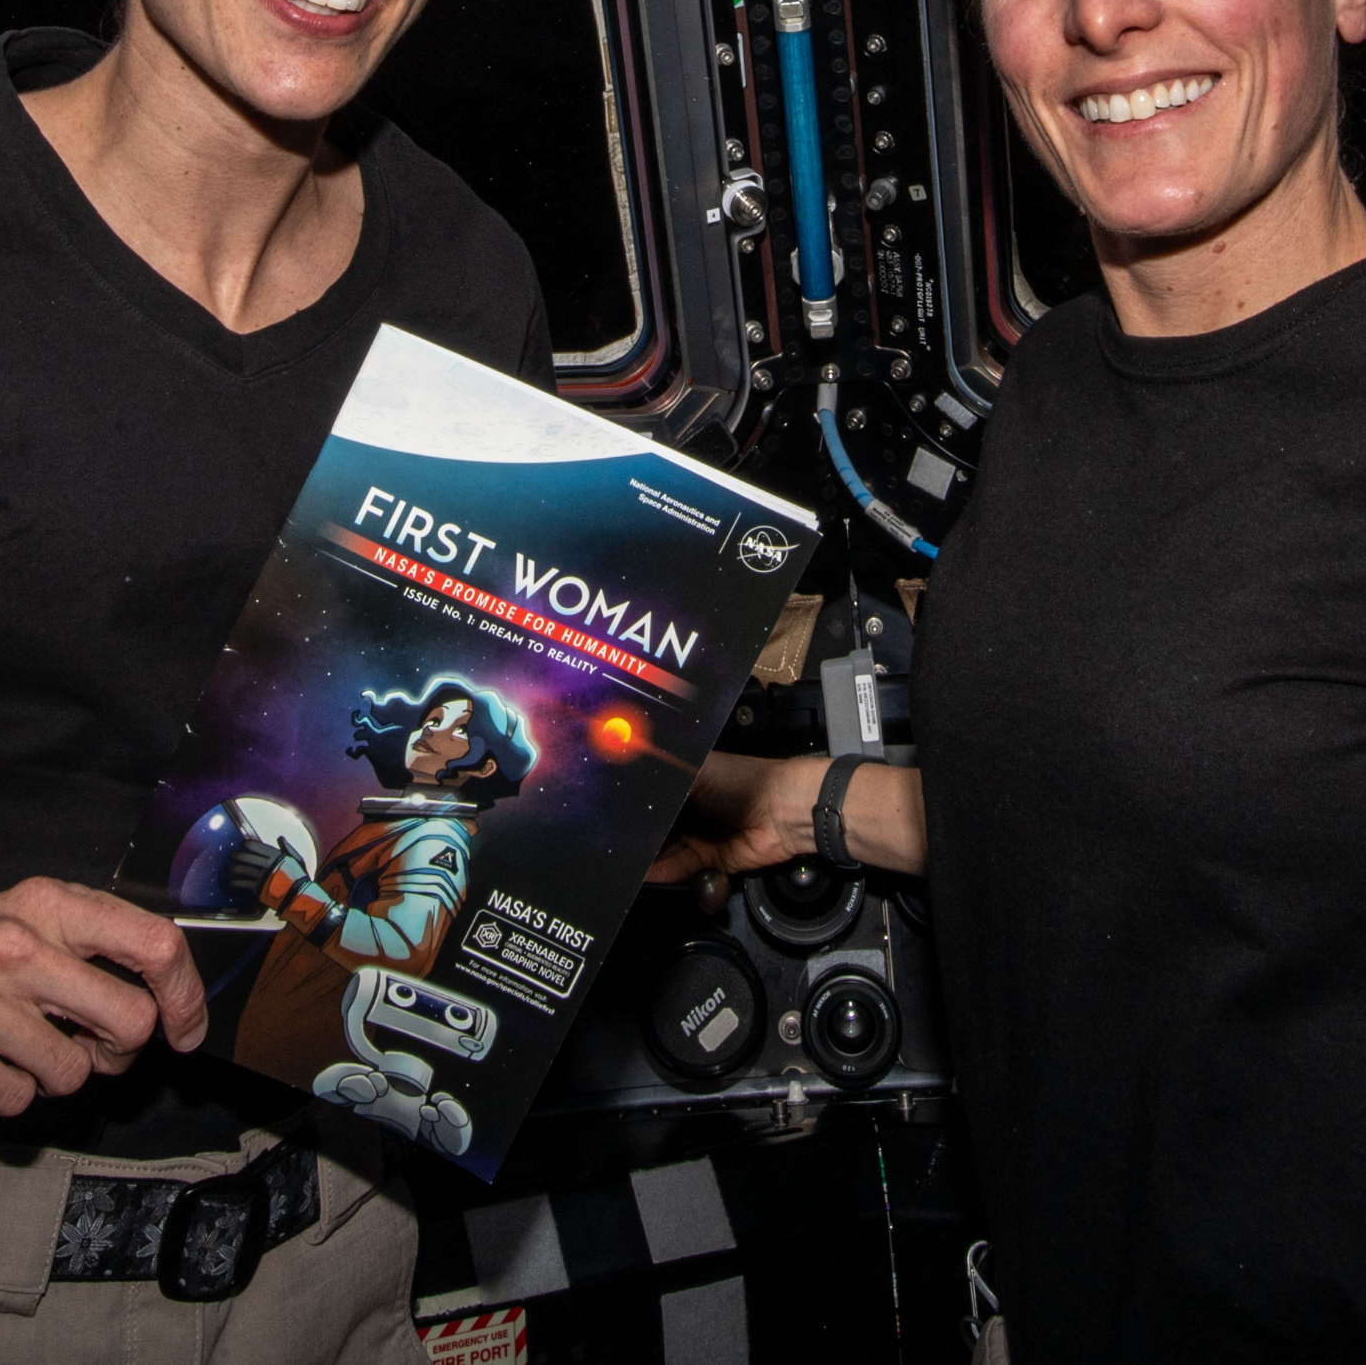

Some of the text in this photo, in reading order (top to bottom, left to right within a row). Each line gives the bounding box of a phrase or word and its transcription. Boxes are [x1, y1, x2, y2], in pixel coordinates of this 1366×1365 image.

[913, 187, 920, 197] 7
[629, 478, 721, 528] National Aeronautics and
[638, 493, 716, 536] Space Administration
[744, 536, 783, 563] NASA
[354, 486, 699, 669] FIRST WOMAN
[373, 546, 648, 677] NASA'S PROMISE FOR HUMANITY
[402, 585, 599, 676] ISSUE No. 1: DREAM TO REALITY
[482, 930, 496, 941] XR
[487, 889, 595, 952] NASA'S FIRST
[501, 948, 567, 987] GRAPHIC NOVEL
[508, 932, 575, 970] XR-ENABLED
[468, 959, 481, 970] For
[480, 965, 498, 978] more
[498, 973, 534, 996] information
[679, 986, 727, 1038] Nikon
[432, 1328, 509, 1355] EMERGENCY USE
[470, 1342, 511, 1365] PORT
